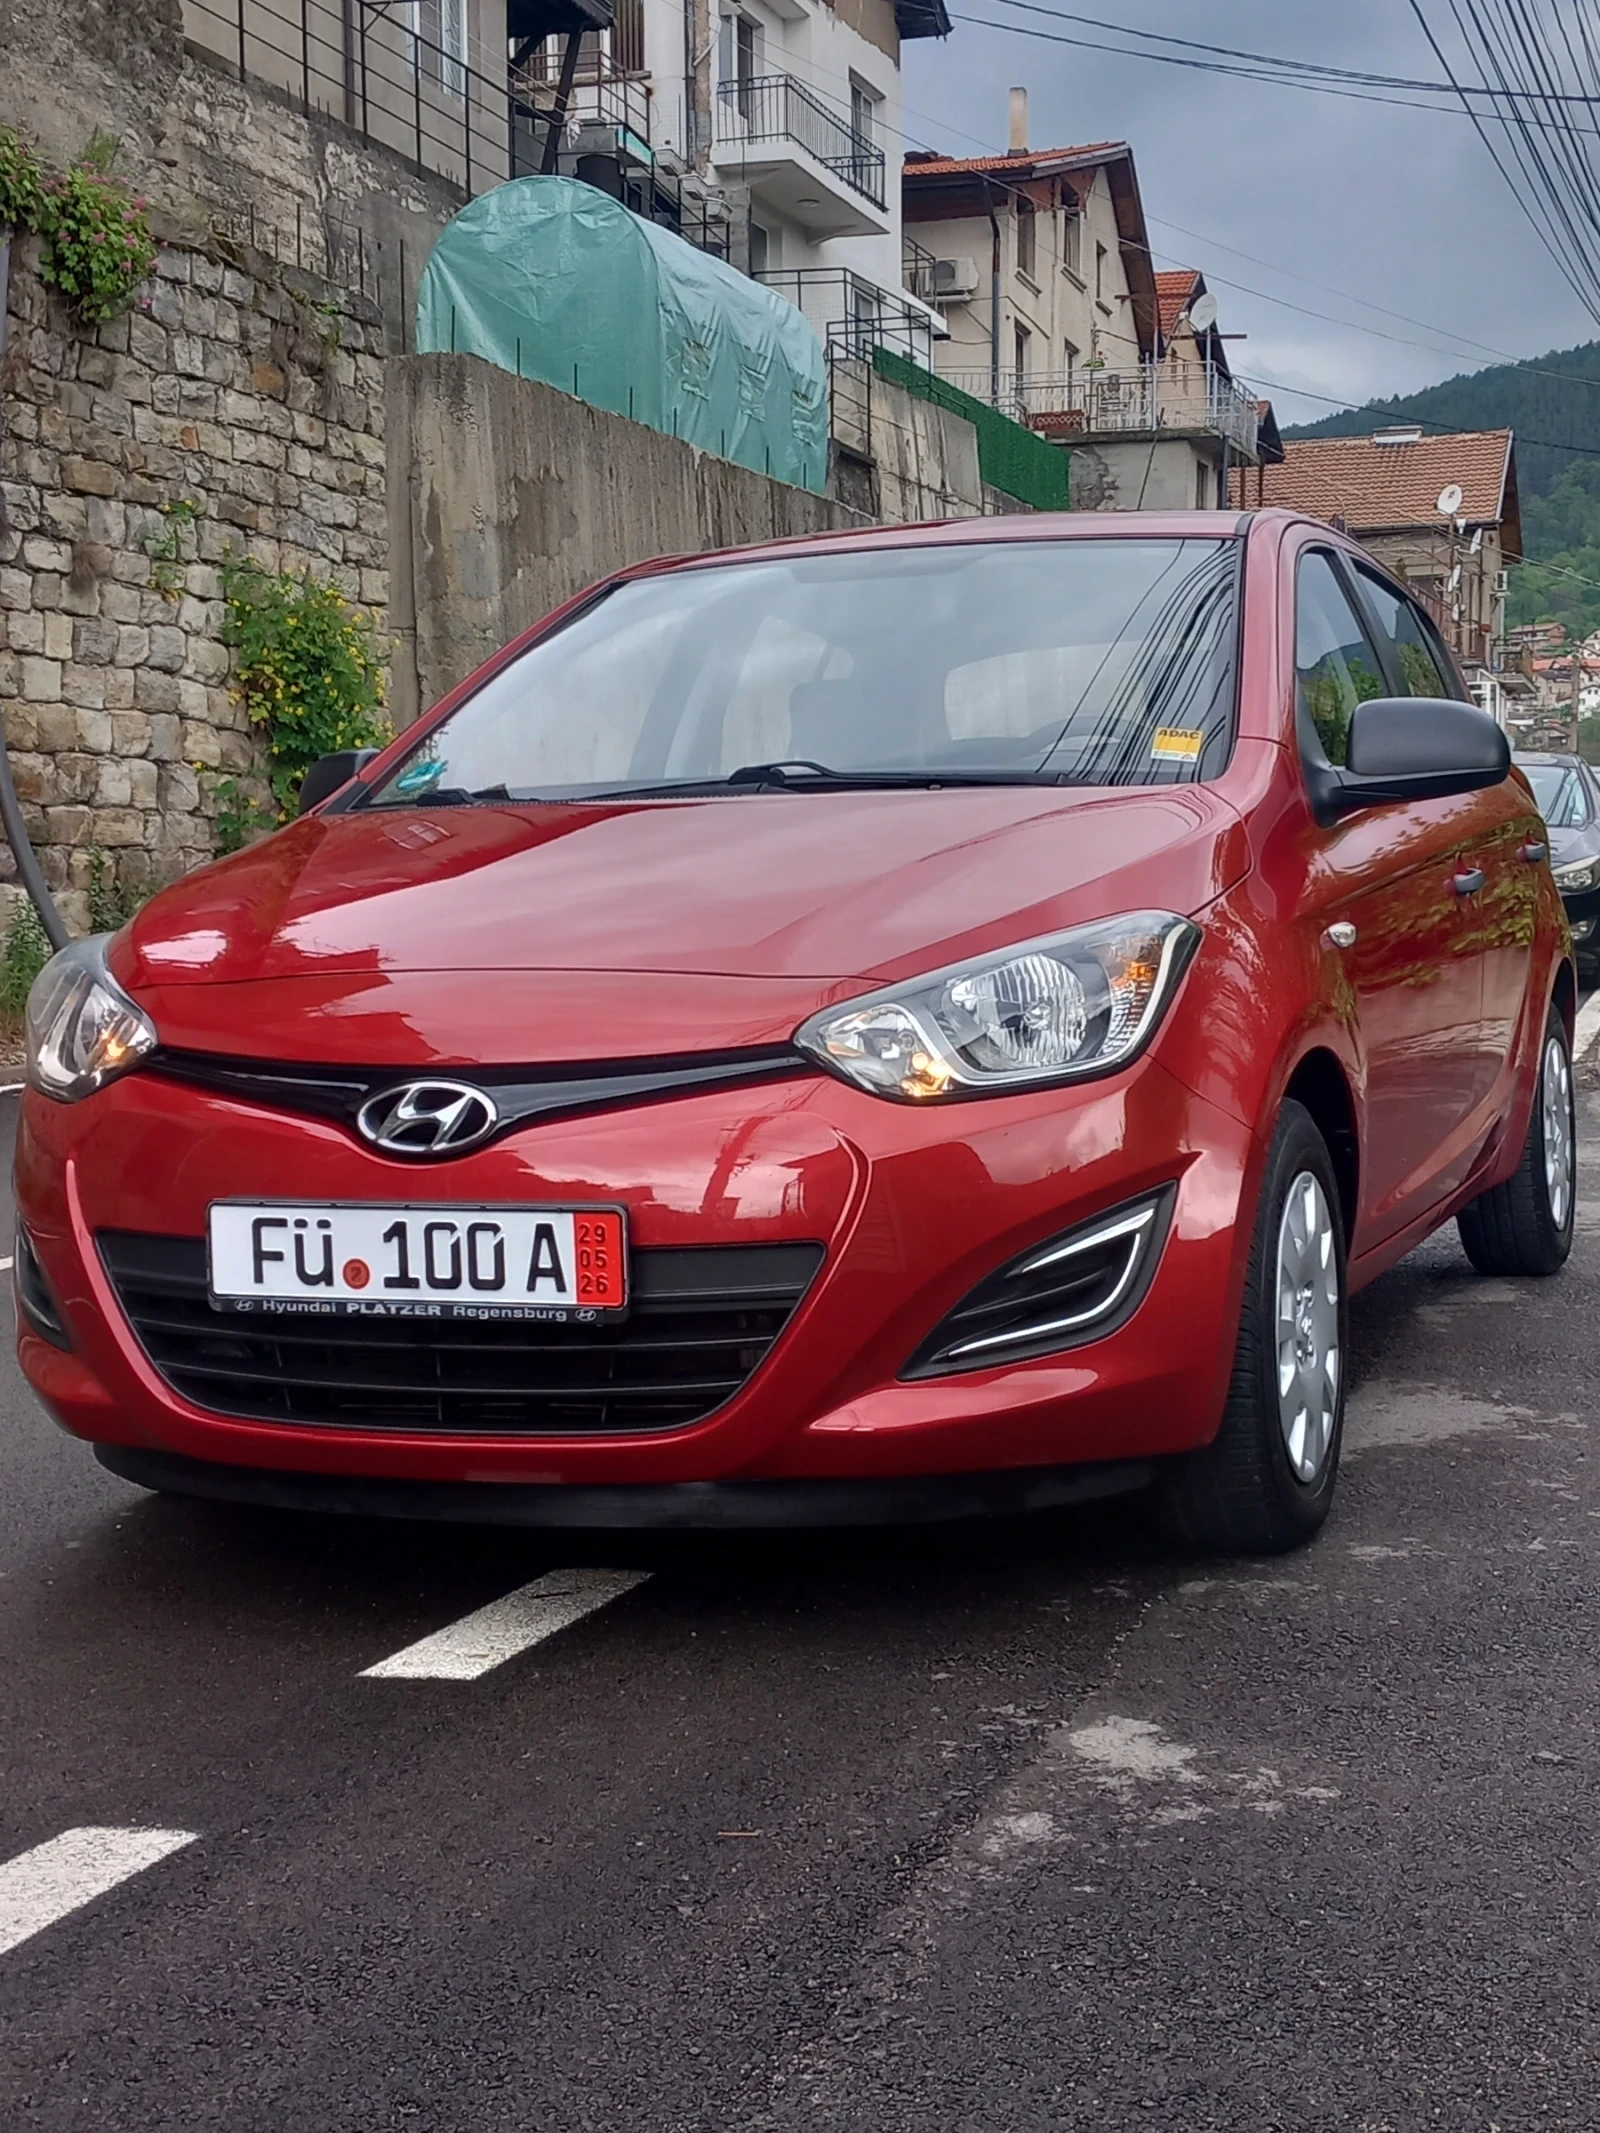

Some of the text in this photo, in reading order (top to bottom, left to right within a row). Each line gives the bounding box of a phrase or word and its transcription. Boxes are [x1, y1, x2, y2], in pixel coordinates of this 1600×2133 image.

[1158, 729, 1199, 740] ADAC
[579, 1222, 607, 1244] 29
[252, 1217, 567, 1293] FÜ 100 A
[580, 1247, 608, 1268] 05
[581, 1272, 609, 1294] 26
[262, 1300, 568, 1322] Hyundai PLATZER Regensburg
